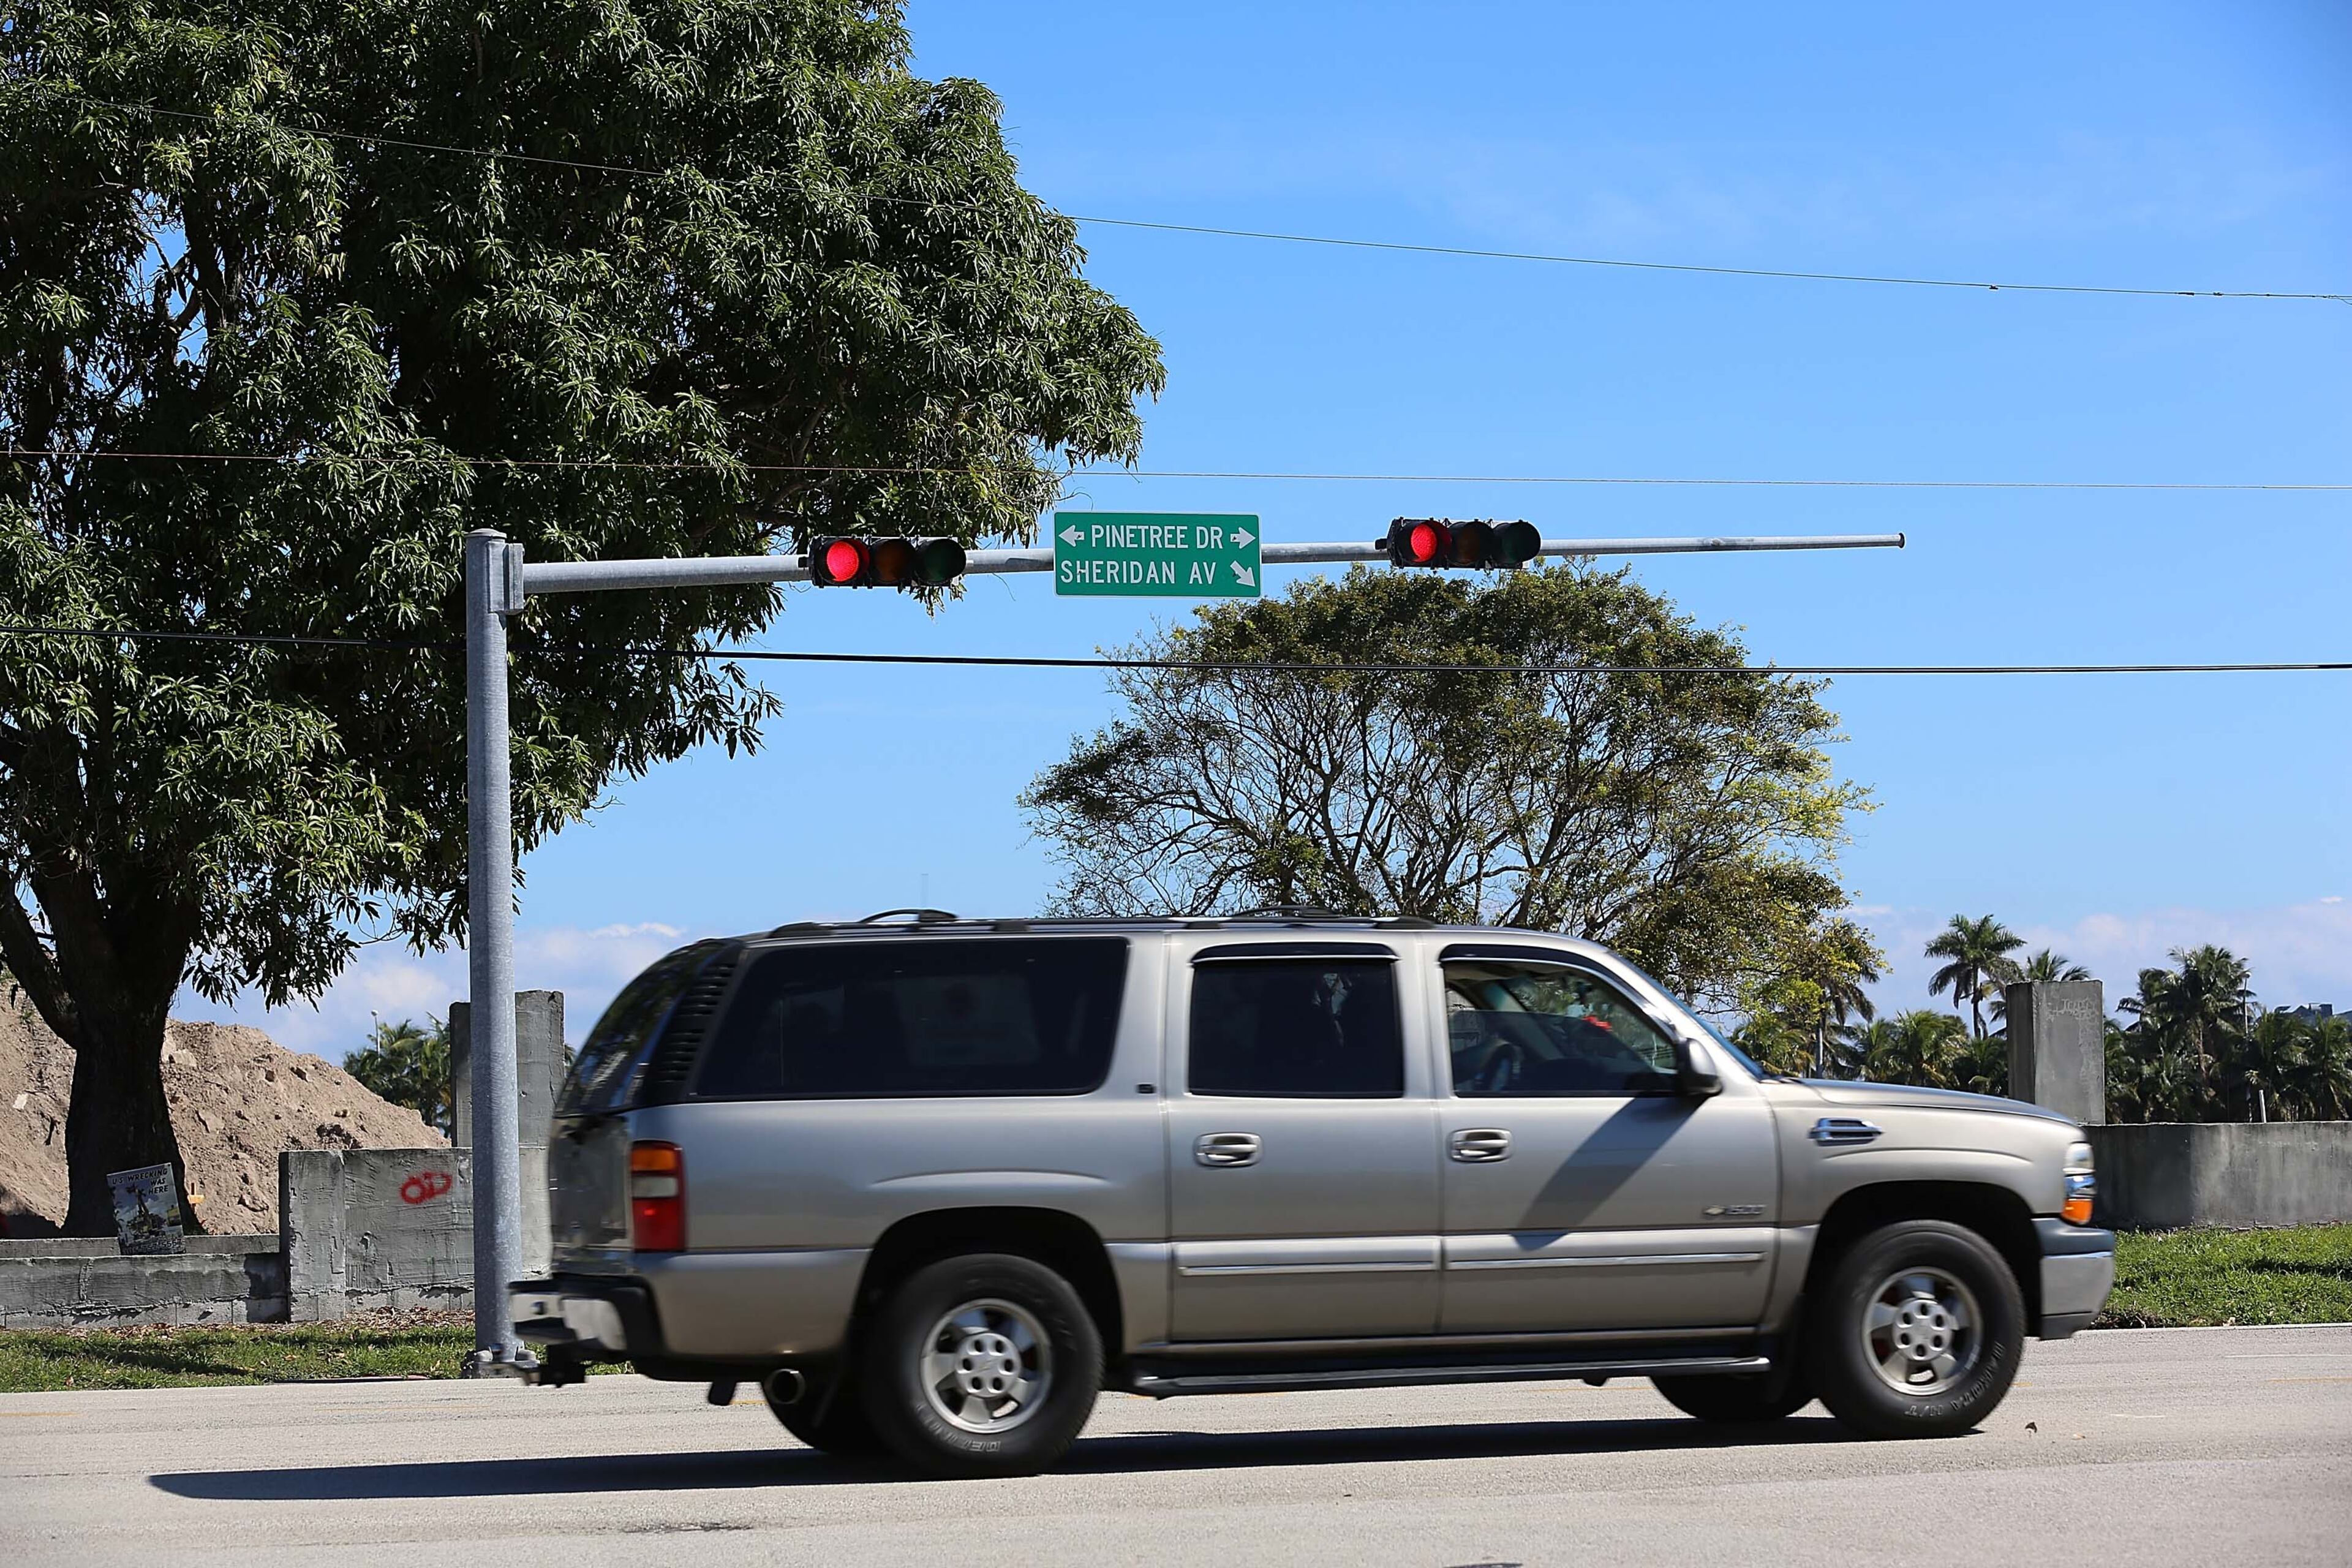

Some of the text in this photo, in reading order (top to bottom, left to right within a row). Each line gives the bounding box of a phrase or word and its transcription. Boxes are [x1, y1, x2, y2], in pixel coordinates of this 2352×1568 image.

[1091, 525, 1224, 549] PINETREE DR
[1060, 560, 1217, 584] SHERIDAN AV
[127, 1168, 168, 1182] WRECKING
[151, 1177, 166, 1186] WAS
[148, 1185, 169, 1195] HERE
